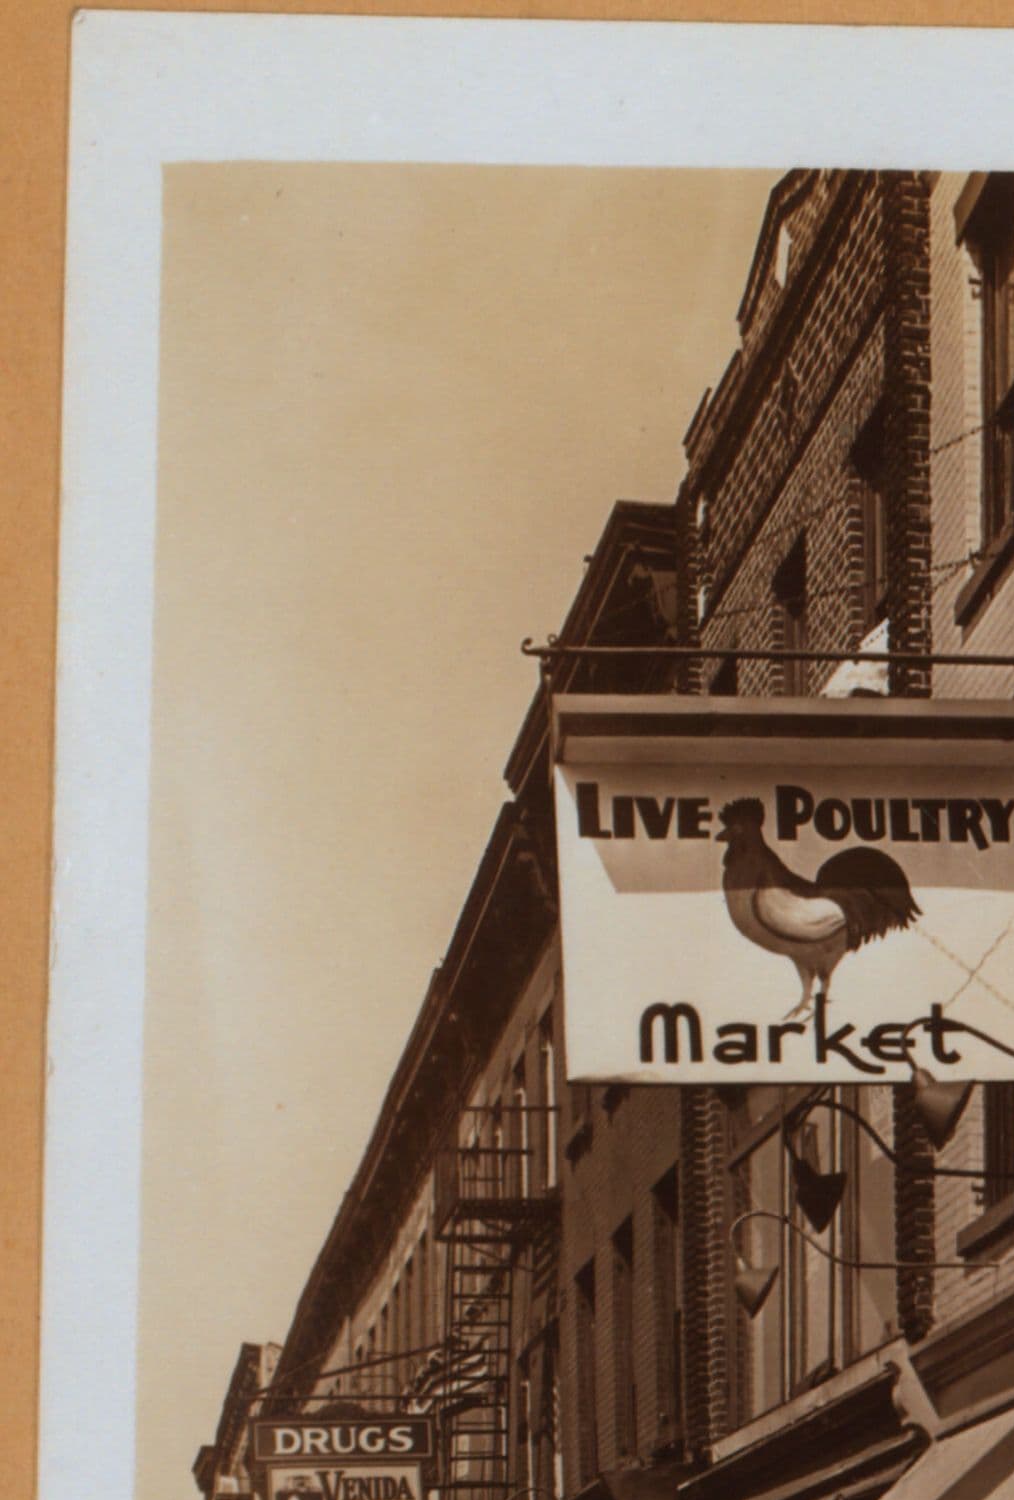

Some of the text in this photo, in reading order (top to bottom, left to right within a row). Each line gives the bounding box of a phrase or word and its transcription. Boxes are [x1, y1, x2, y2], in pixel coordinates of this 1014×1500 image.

[575, 782, 711, 840] LIVE
[639, 992, 963, 1075] Market
[273, 1426, 414, 1455] DRUGS
